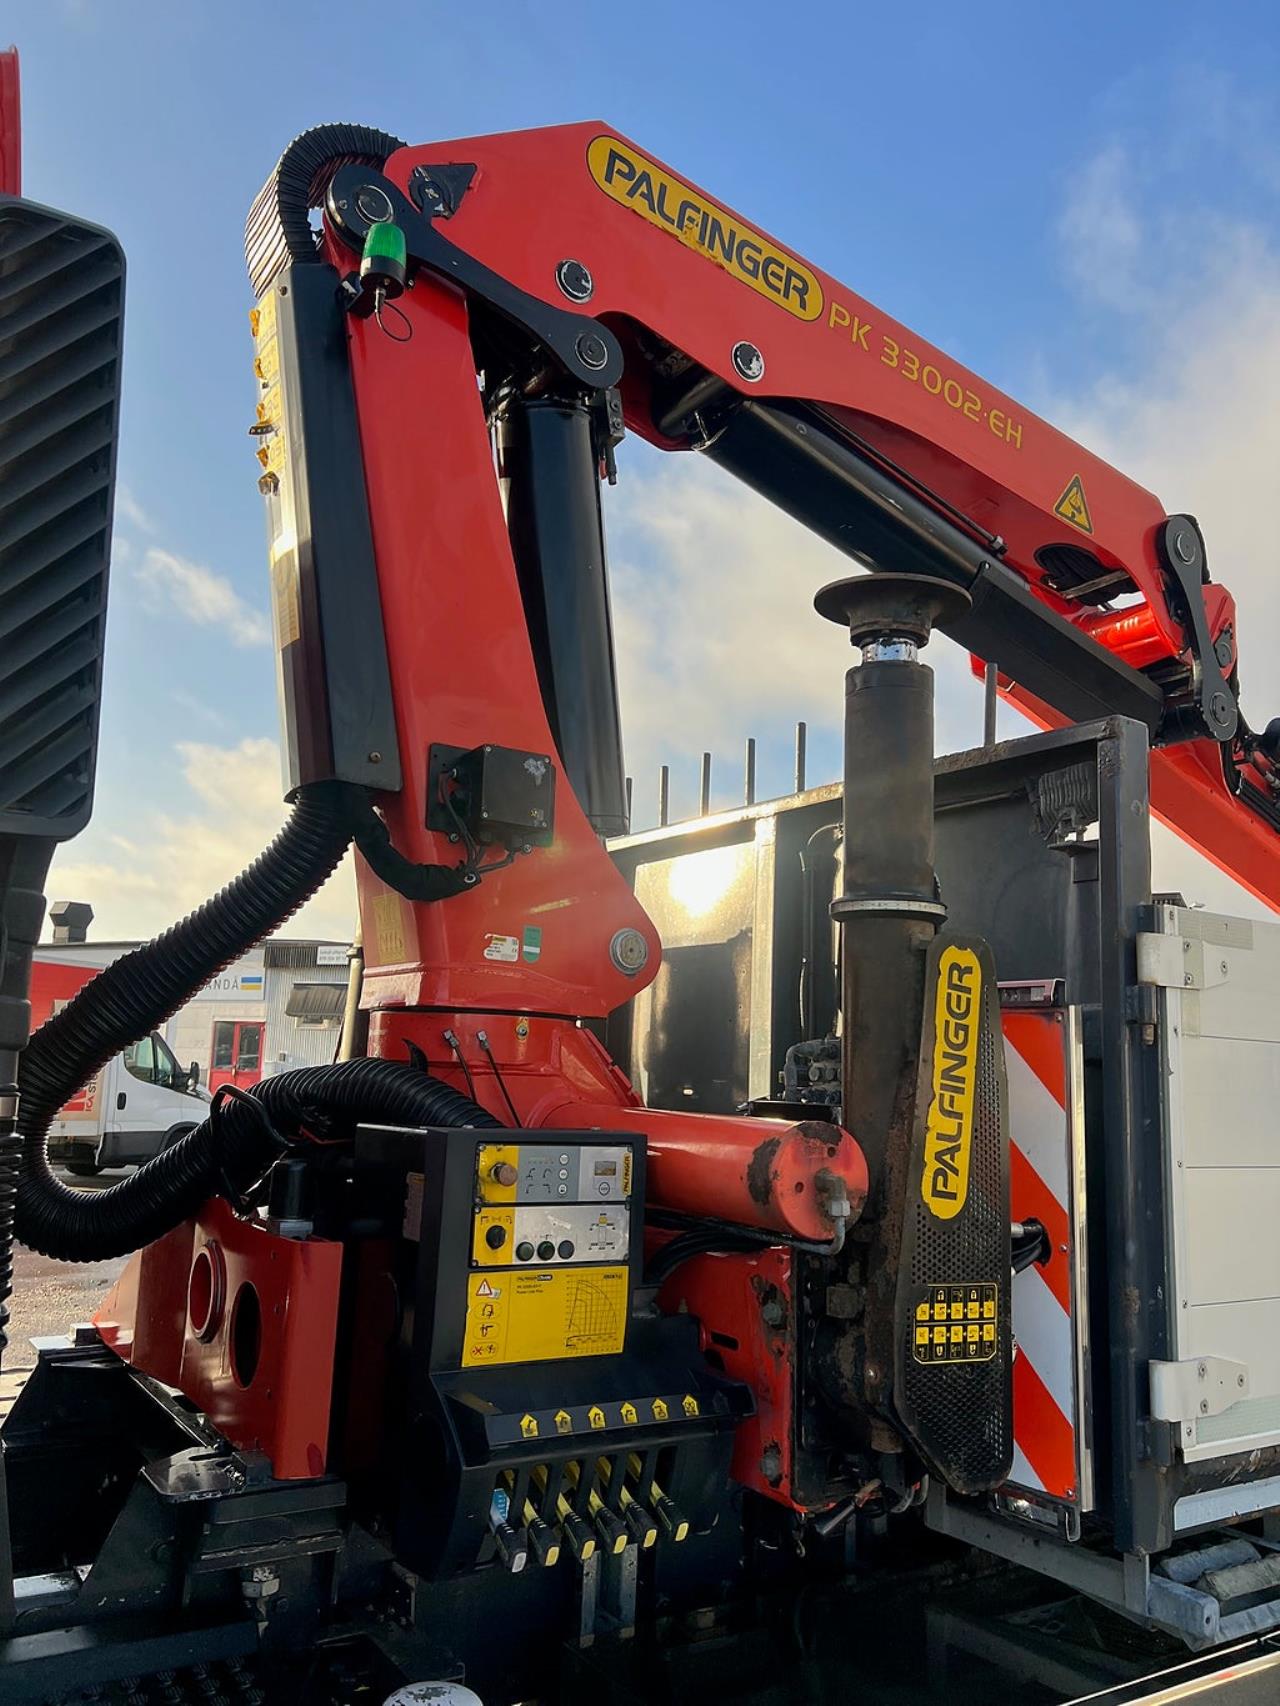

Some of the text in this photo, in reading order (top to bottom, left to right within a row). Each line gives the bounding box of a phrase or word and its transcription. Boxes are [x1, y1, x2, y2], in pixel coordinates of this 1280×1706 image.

[604, 148, 809, 311] PALFINGER
[829, 302, 872, 351] PK
[931, 961, 973, 1201] PALFINGER
